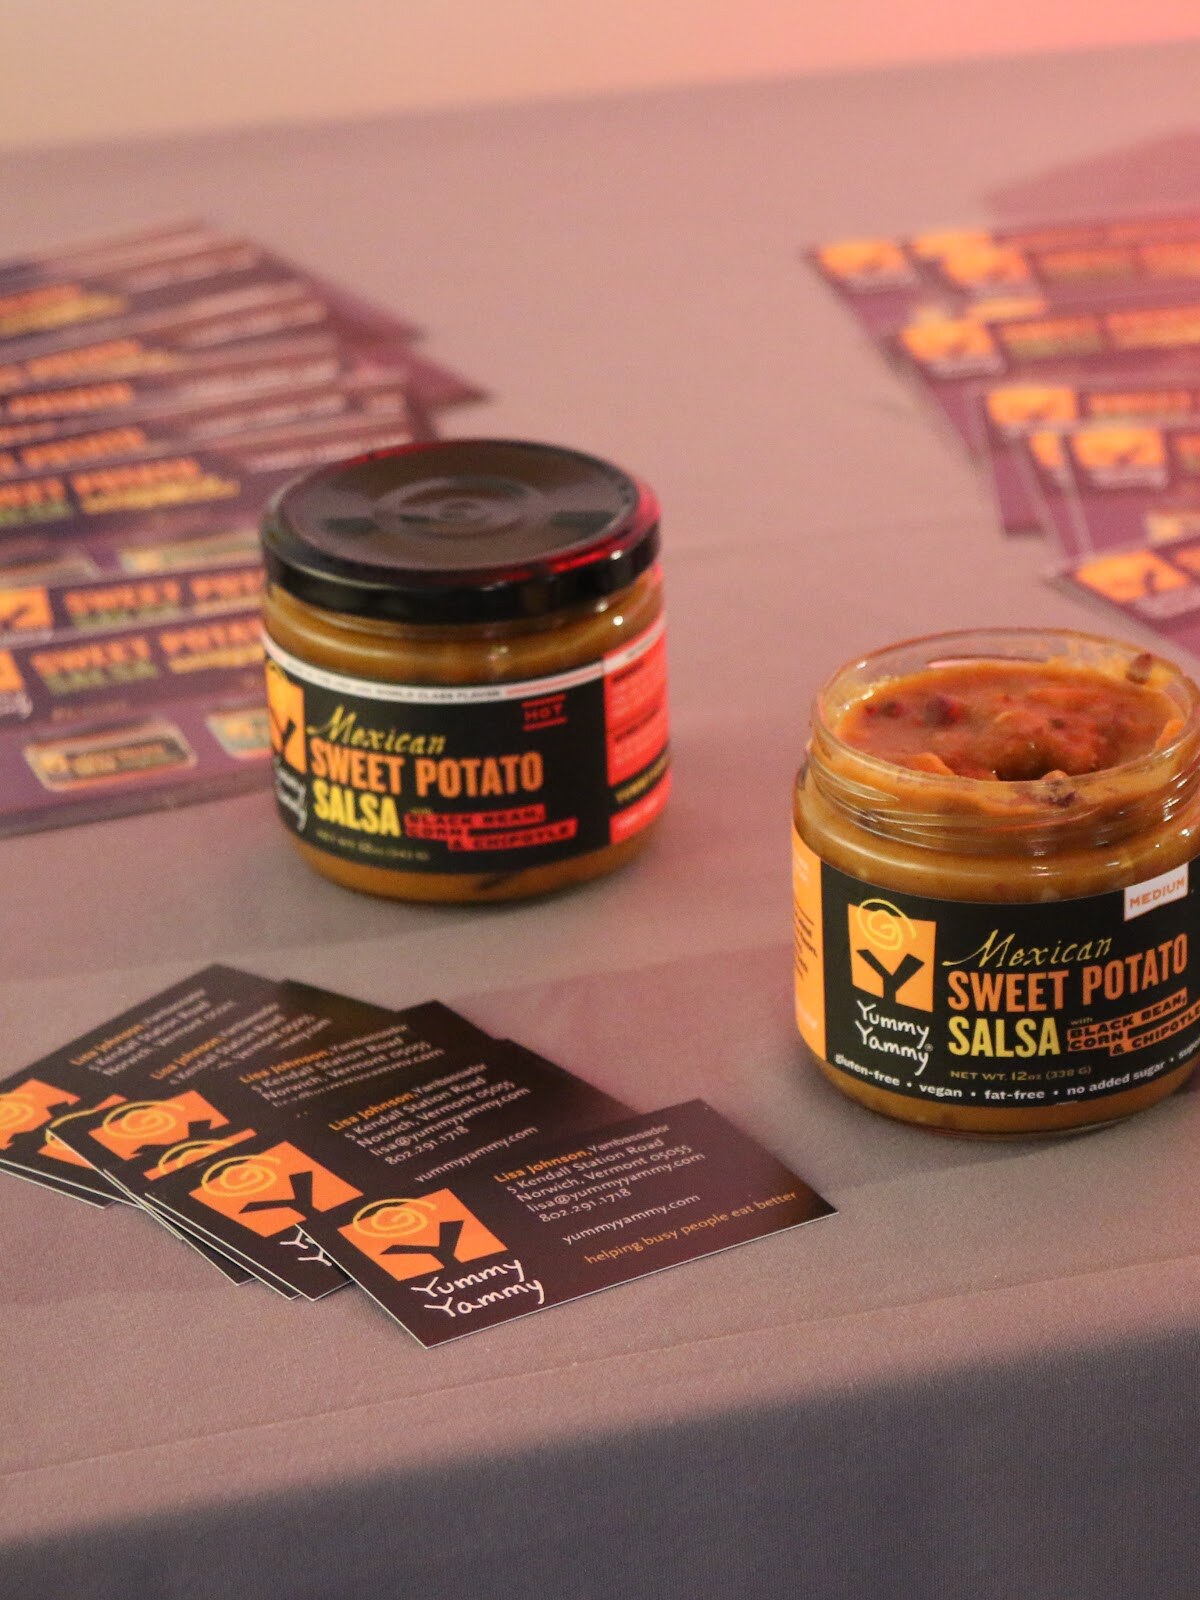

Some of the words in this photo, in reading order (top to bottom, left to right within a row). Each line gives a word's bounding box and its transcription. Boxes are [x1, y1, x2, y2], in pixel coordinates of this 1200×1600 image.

[306, 704, 447, 755] Mexican
[524, 704, 562, 721] HOT
[310, 736, 405, 795] SWEET
[415, 751, 544, 799] POTATO
[312, 780, 400, 838] SALSA
[1128, 877, 1186, 909] MEDIUM
[942, 929, 1113, 969] Mexican
[947, 969, 1070, 1013] SWEET
[1082, 933, 1188, 1006] POTATO
[856, 1000, 930, 1050] Yummy
[948, 1015, 1061, 1058] SALSA
[1069, 1030, 1124, 1051] CORN
[1070, 1015, 1134, 1039] BLACK
[1140, 993, 1186, 1022] BEAN,
[1070, 1016, 1094, 1026] with
[261, 1065, 315, 1088] Kendall
[314, 1049, 367, 1071] Station
[366, 1035, 405, 1053] Road
[855, 1020, 930, 1076] Yammy
[1112, 1043, 1125, 1055] &
[239, 1070, 271, 1084] Lisa
[261, 1075, 329, 1101] Norwich,
[326, 1053, 389, 1078] Vermont
[835, 1053, 901, 1089] gluten-free
[919, 1083, 963, 1100] vegan
[984, 1088, 1046, 1101] fat-free
[1066, 1086, 1086, 1096] no
[1089, 1073, 1131, 1092] added
[1133, 1060, 1166, 1081] sugar
[950, 1070, 979, 1080] NET
[1011, 1070, 1042, 1082] 12oz
[328, 1116, 360, 1132] Lisa
[358, 1091, 420, 1121] Johnson,
[344, 1131, 357, 1141] 5
[352, 1108, 405, 1135] Kendall
[402, 1090, 451, 1114] Station
[450, 1075, 487, 1095] Road
[356, 1119, 421, 1148] Norwich,
[414, 1094, 477, 1122] Vermont
[475, 1079, 517, 1100] 05055
[369, 1086, 532, 1157] lisa@yummyyammy.com
[384, 1124, 470, 1166] 802.291.1718
[413, 1126, 539, 1183] yummyyammy.com
[493, 1168, 527, 1184] Lisa
[528, 1149, 593, 1175] Johnson,
[587, 1124, 671, 1154] Yambassador
[506, 1185, 517, 1195] 5
[516, 1167, 572, 1191] Kendall
[572, 1151, 626, 1173] Station
[626, 1138, 666, 1156] Road
[515, 1178, 585, 1203] Norwich,
[583, 1156, 649, 1181] Vermont
[649, 1144, 693, 1163] 05055
[526, 1152, 706, 1213] lisa@yummyyammy.com
[538, 1187, 632, 1224] 802.291.1718
[561, 1193, 702, 1246] yummyyammy.com
[584, 1241, 644, 1266] helping
[643, 1229, 679, 1247] busy
[680, 1213, 730, 1236] people
[731, 1205, 755, 1218] eat
[755, 1190, 798, 1211] better
[410, 1259, 526, 1299] Yummy
[424, 1279, 546, 1318] Yammy
